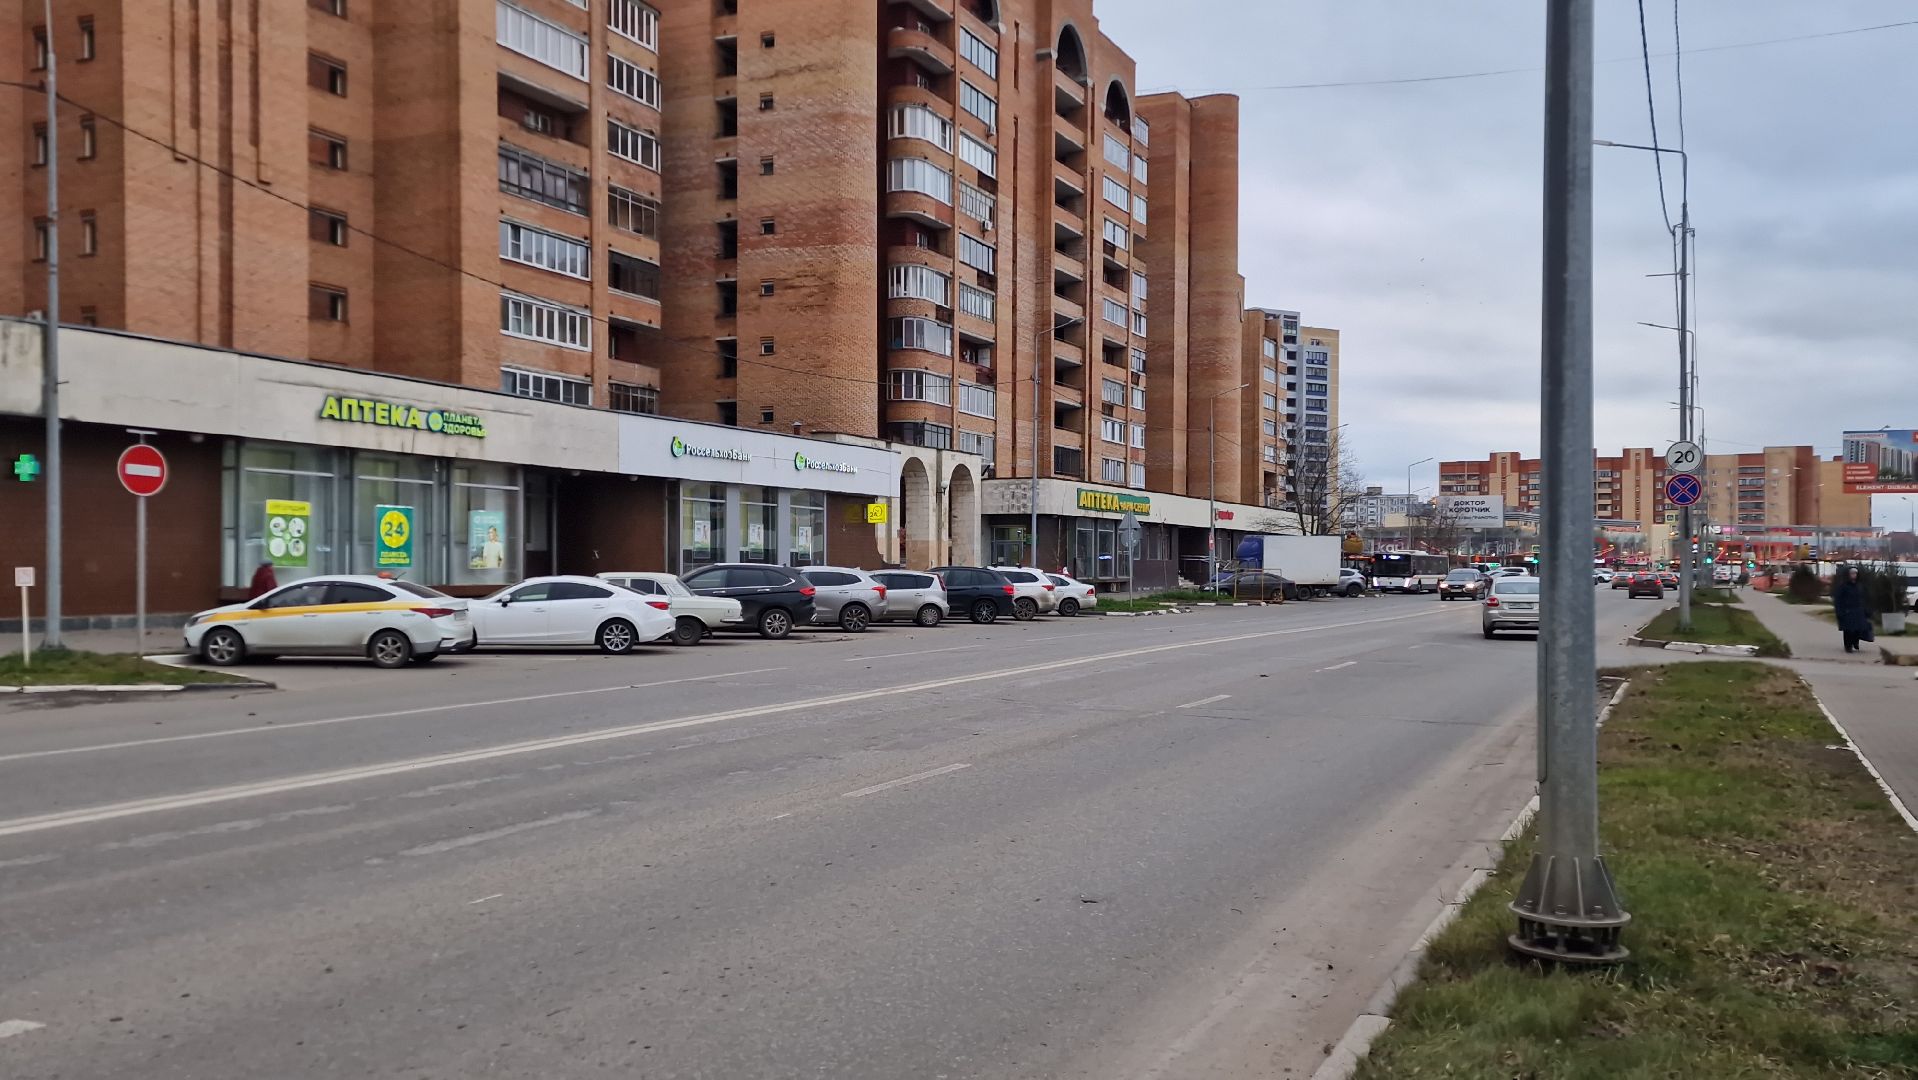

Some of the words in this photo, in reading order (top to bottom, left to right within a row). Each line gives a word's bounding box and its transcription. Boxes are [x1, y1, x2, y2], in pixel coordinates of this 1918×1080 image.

[321, 396, 422, 429] АПТЕКА
[443, 412, 482, 426] ПЛАНЕТА
[1674, 450, 1695, 463] 20
[1079, 491, 1120, 511] АПТЕКА
[384, 521, 405, 537] 24
